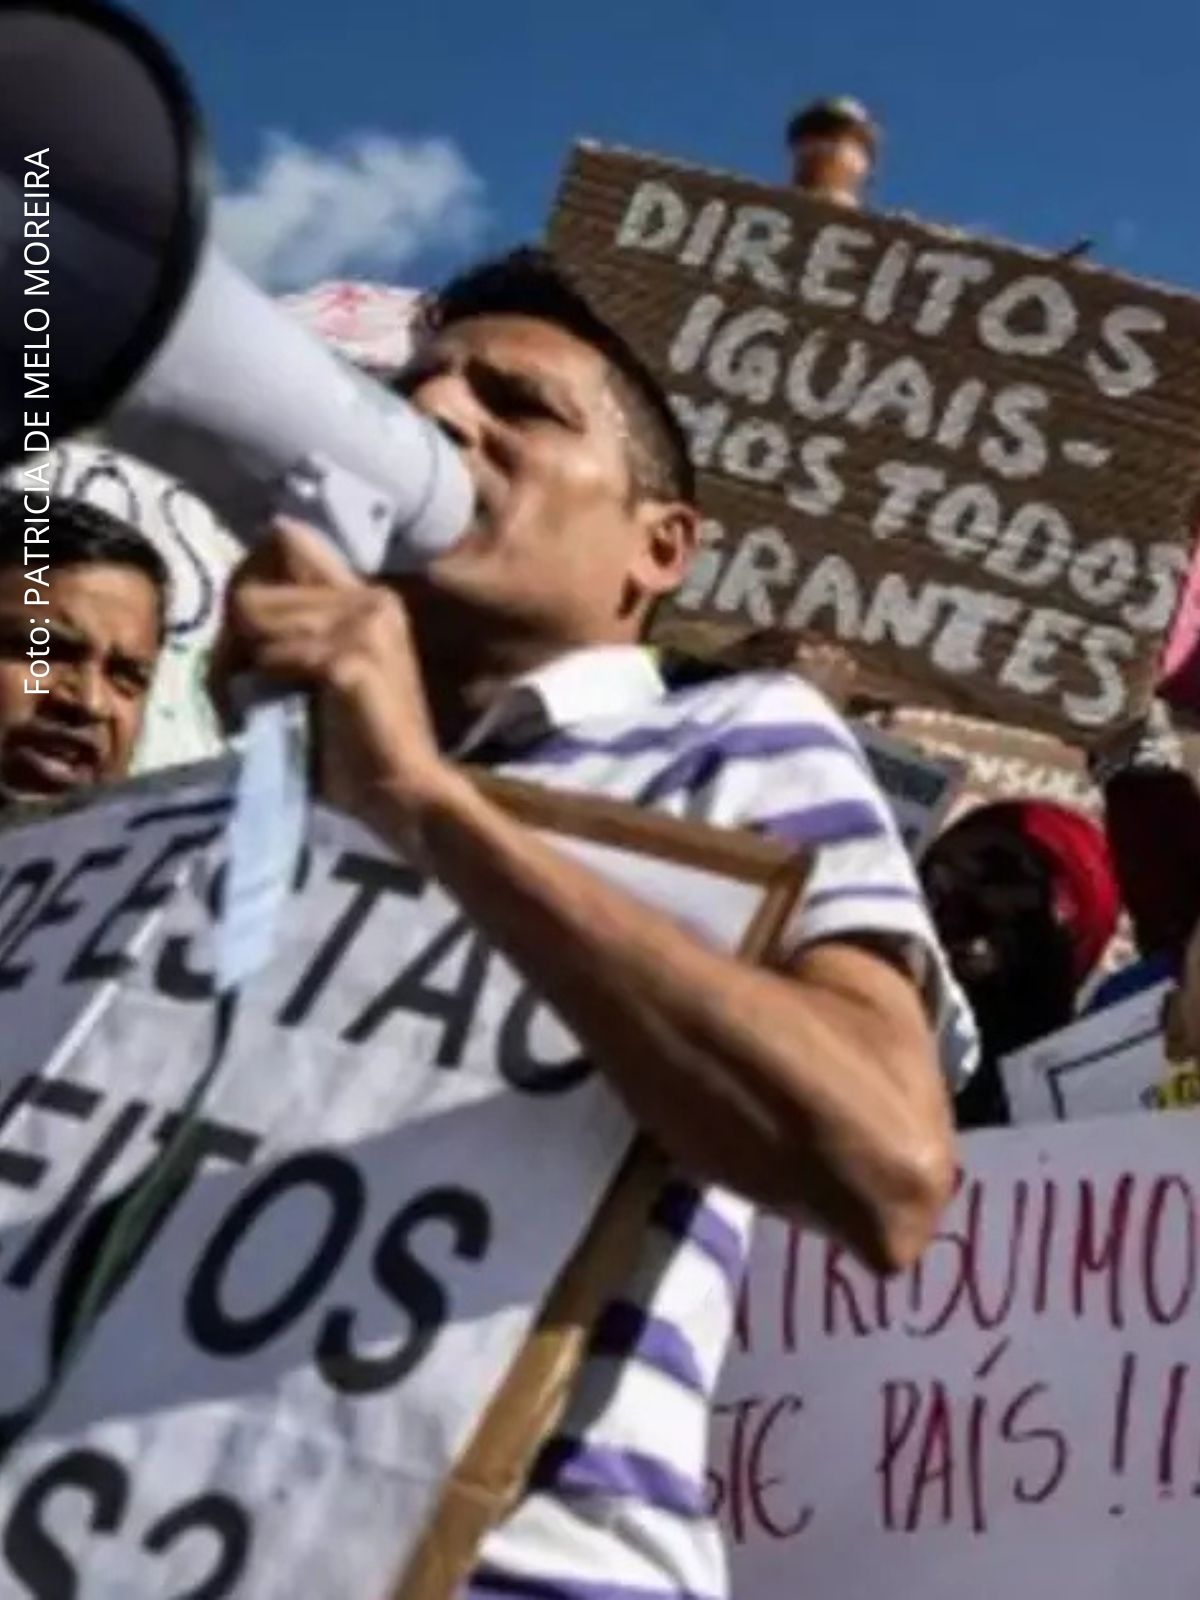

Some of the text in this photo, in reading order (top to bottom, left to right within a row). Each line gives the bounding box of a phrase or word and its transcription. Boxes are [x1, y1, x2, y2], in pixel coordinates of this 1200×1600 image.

[614, 181, 1167, 399] DIREITOS
[872, 461, 1189, 631] TODOS
[876, 1337, 1070, 1533] PAÍS
